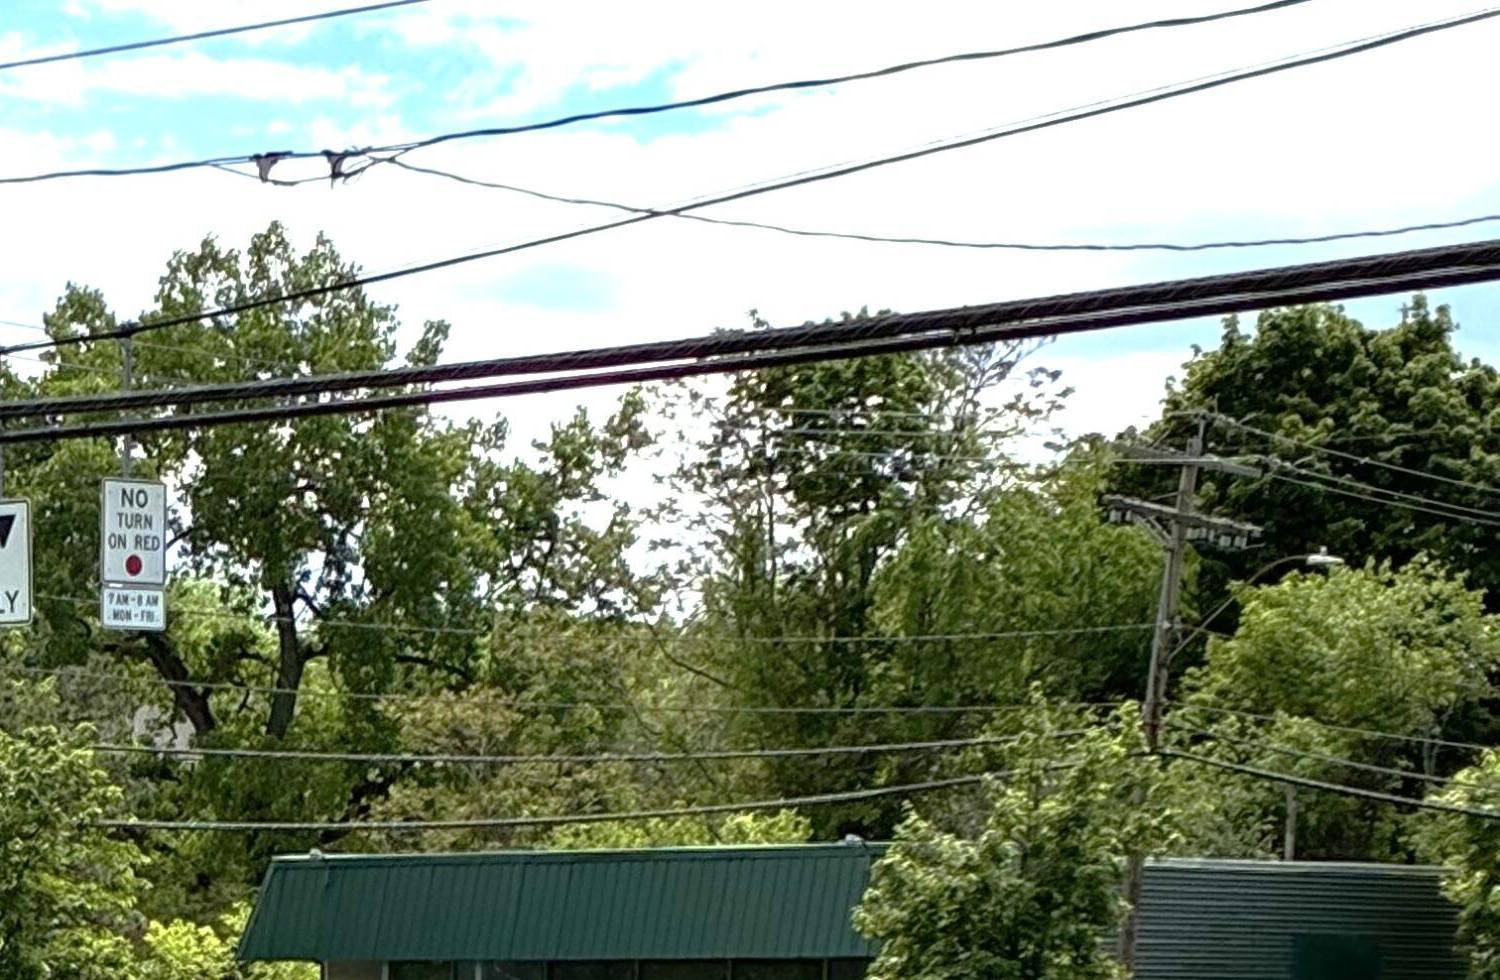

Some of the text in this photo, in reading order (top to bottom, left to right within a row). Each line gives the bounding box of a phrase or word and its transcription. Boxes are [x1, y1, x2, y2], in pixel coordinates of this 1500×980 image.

[121, 488, 148, 508] NO
[117, 512, 153, 530] TURN
[108, 533, 160, 551] ON RED
